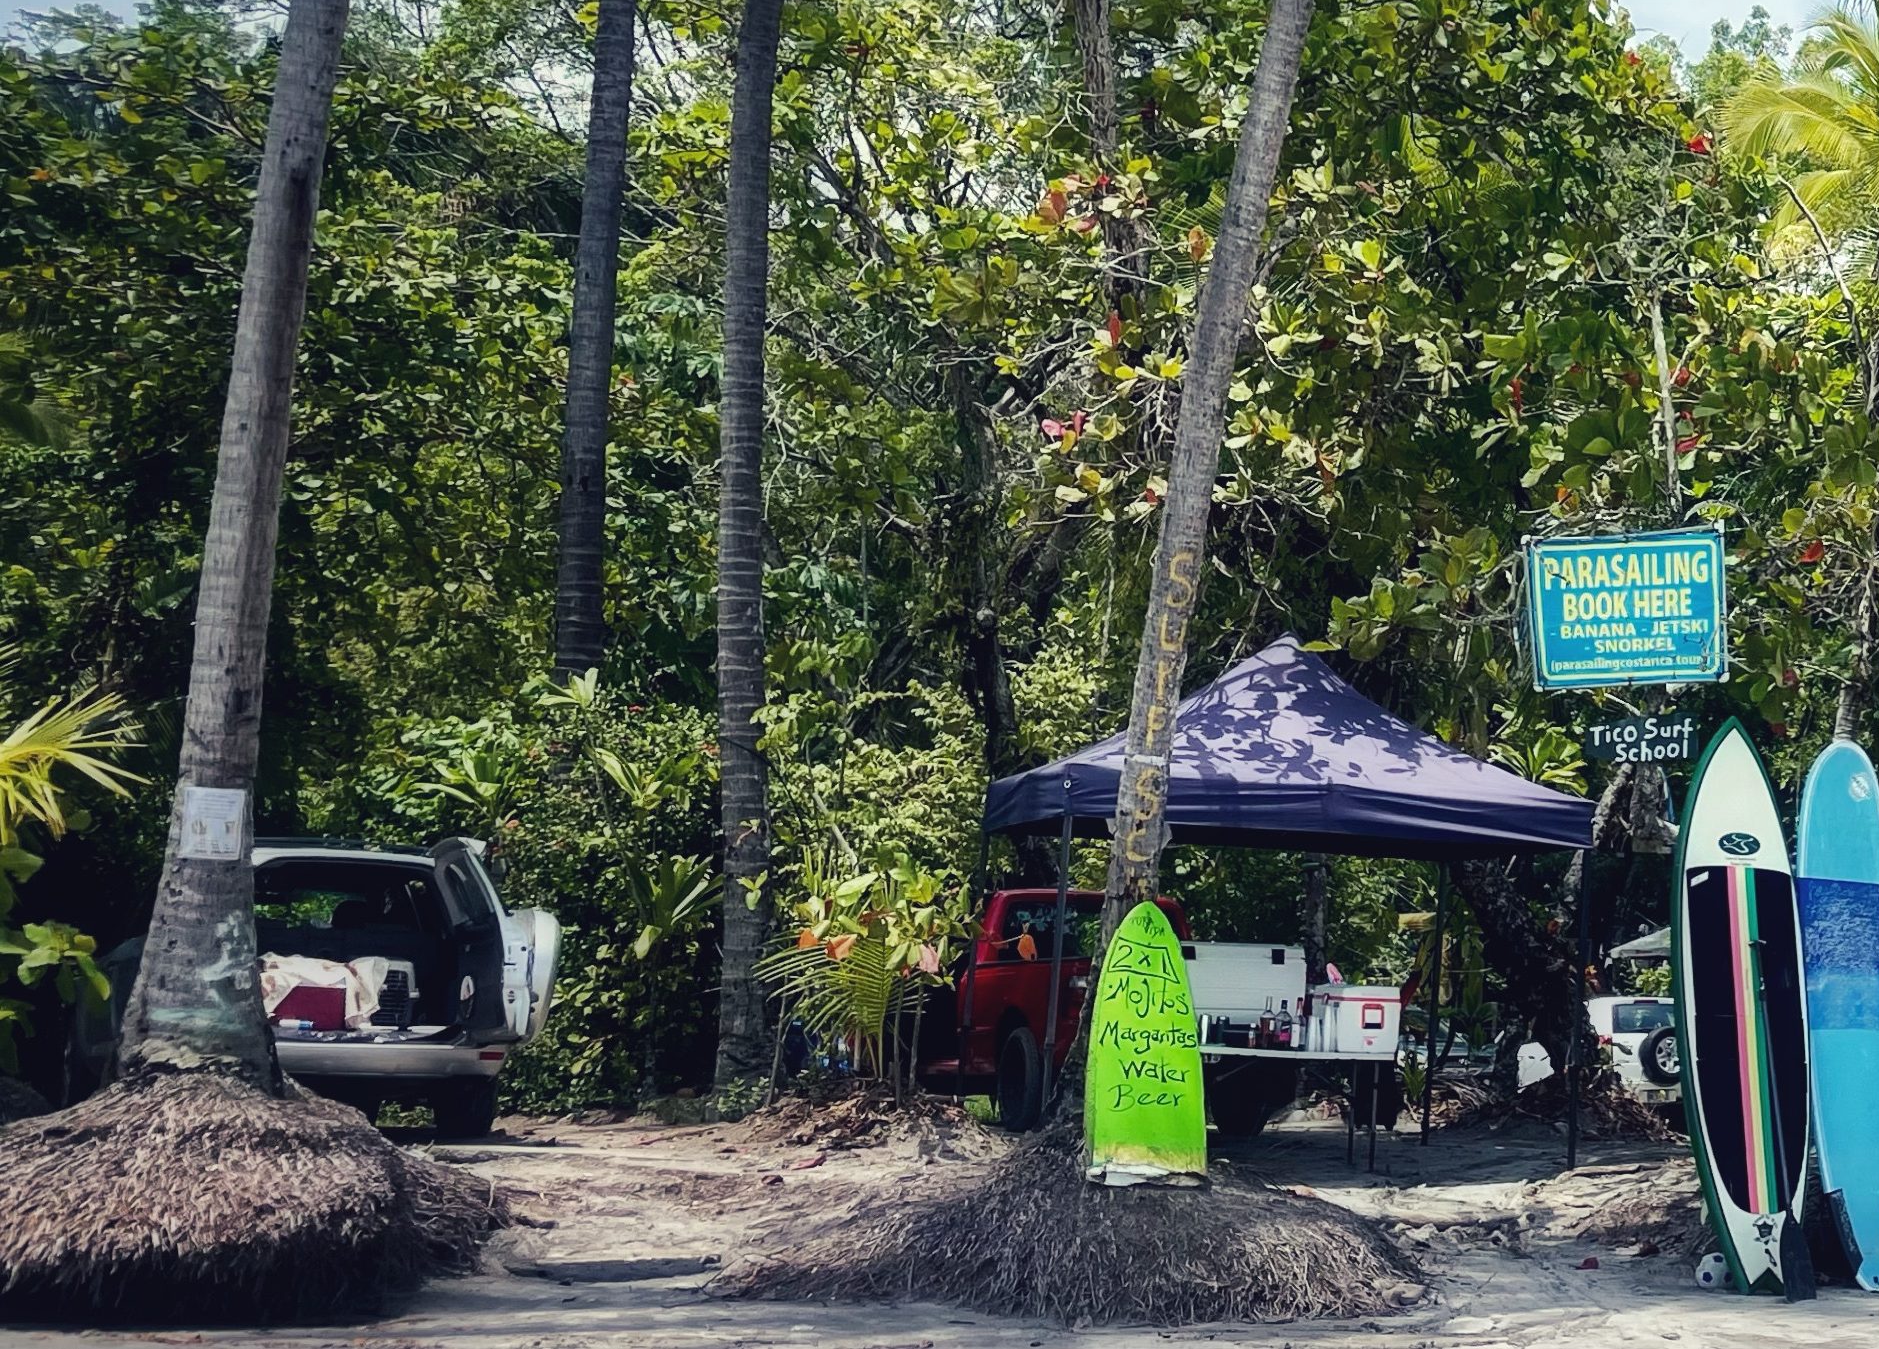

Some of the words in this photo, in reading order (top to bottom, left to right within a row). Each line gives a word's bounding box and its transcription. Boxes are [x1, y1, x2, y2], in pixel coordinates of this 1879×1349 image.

[1543, 551, 1709, 590] PARASAILING
[1562, 591, 1628, 622] BOOK
[1633, 588, 1693, 619] HERE
[1560, 622, 1636, 640] BANANA
[1651, 619, 1708, 636] JETSKI
[1594, 637, 1676, 653] SNORKEL
[1589, 725, 1638, 746] Tico
[1643, 718, 1694, 739] Surf
[1614, 739, 1688, 762] School
[1111, 944, 1133, 969] 2
[1099, 1020, 1197, 1054] Margaritas
[1107, 1083, 1187, 1112] Beer
